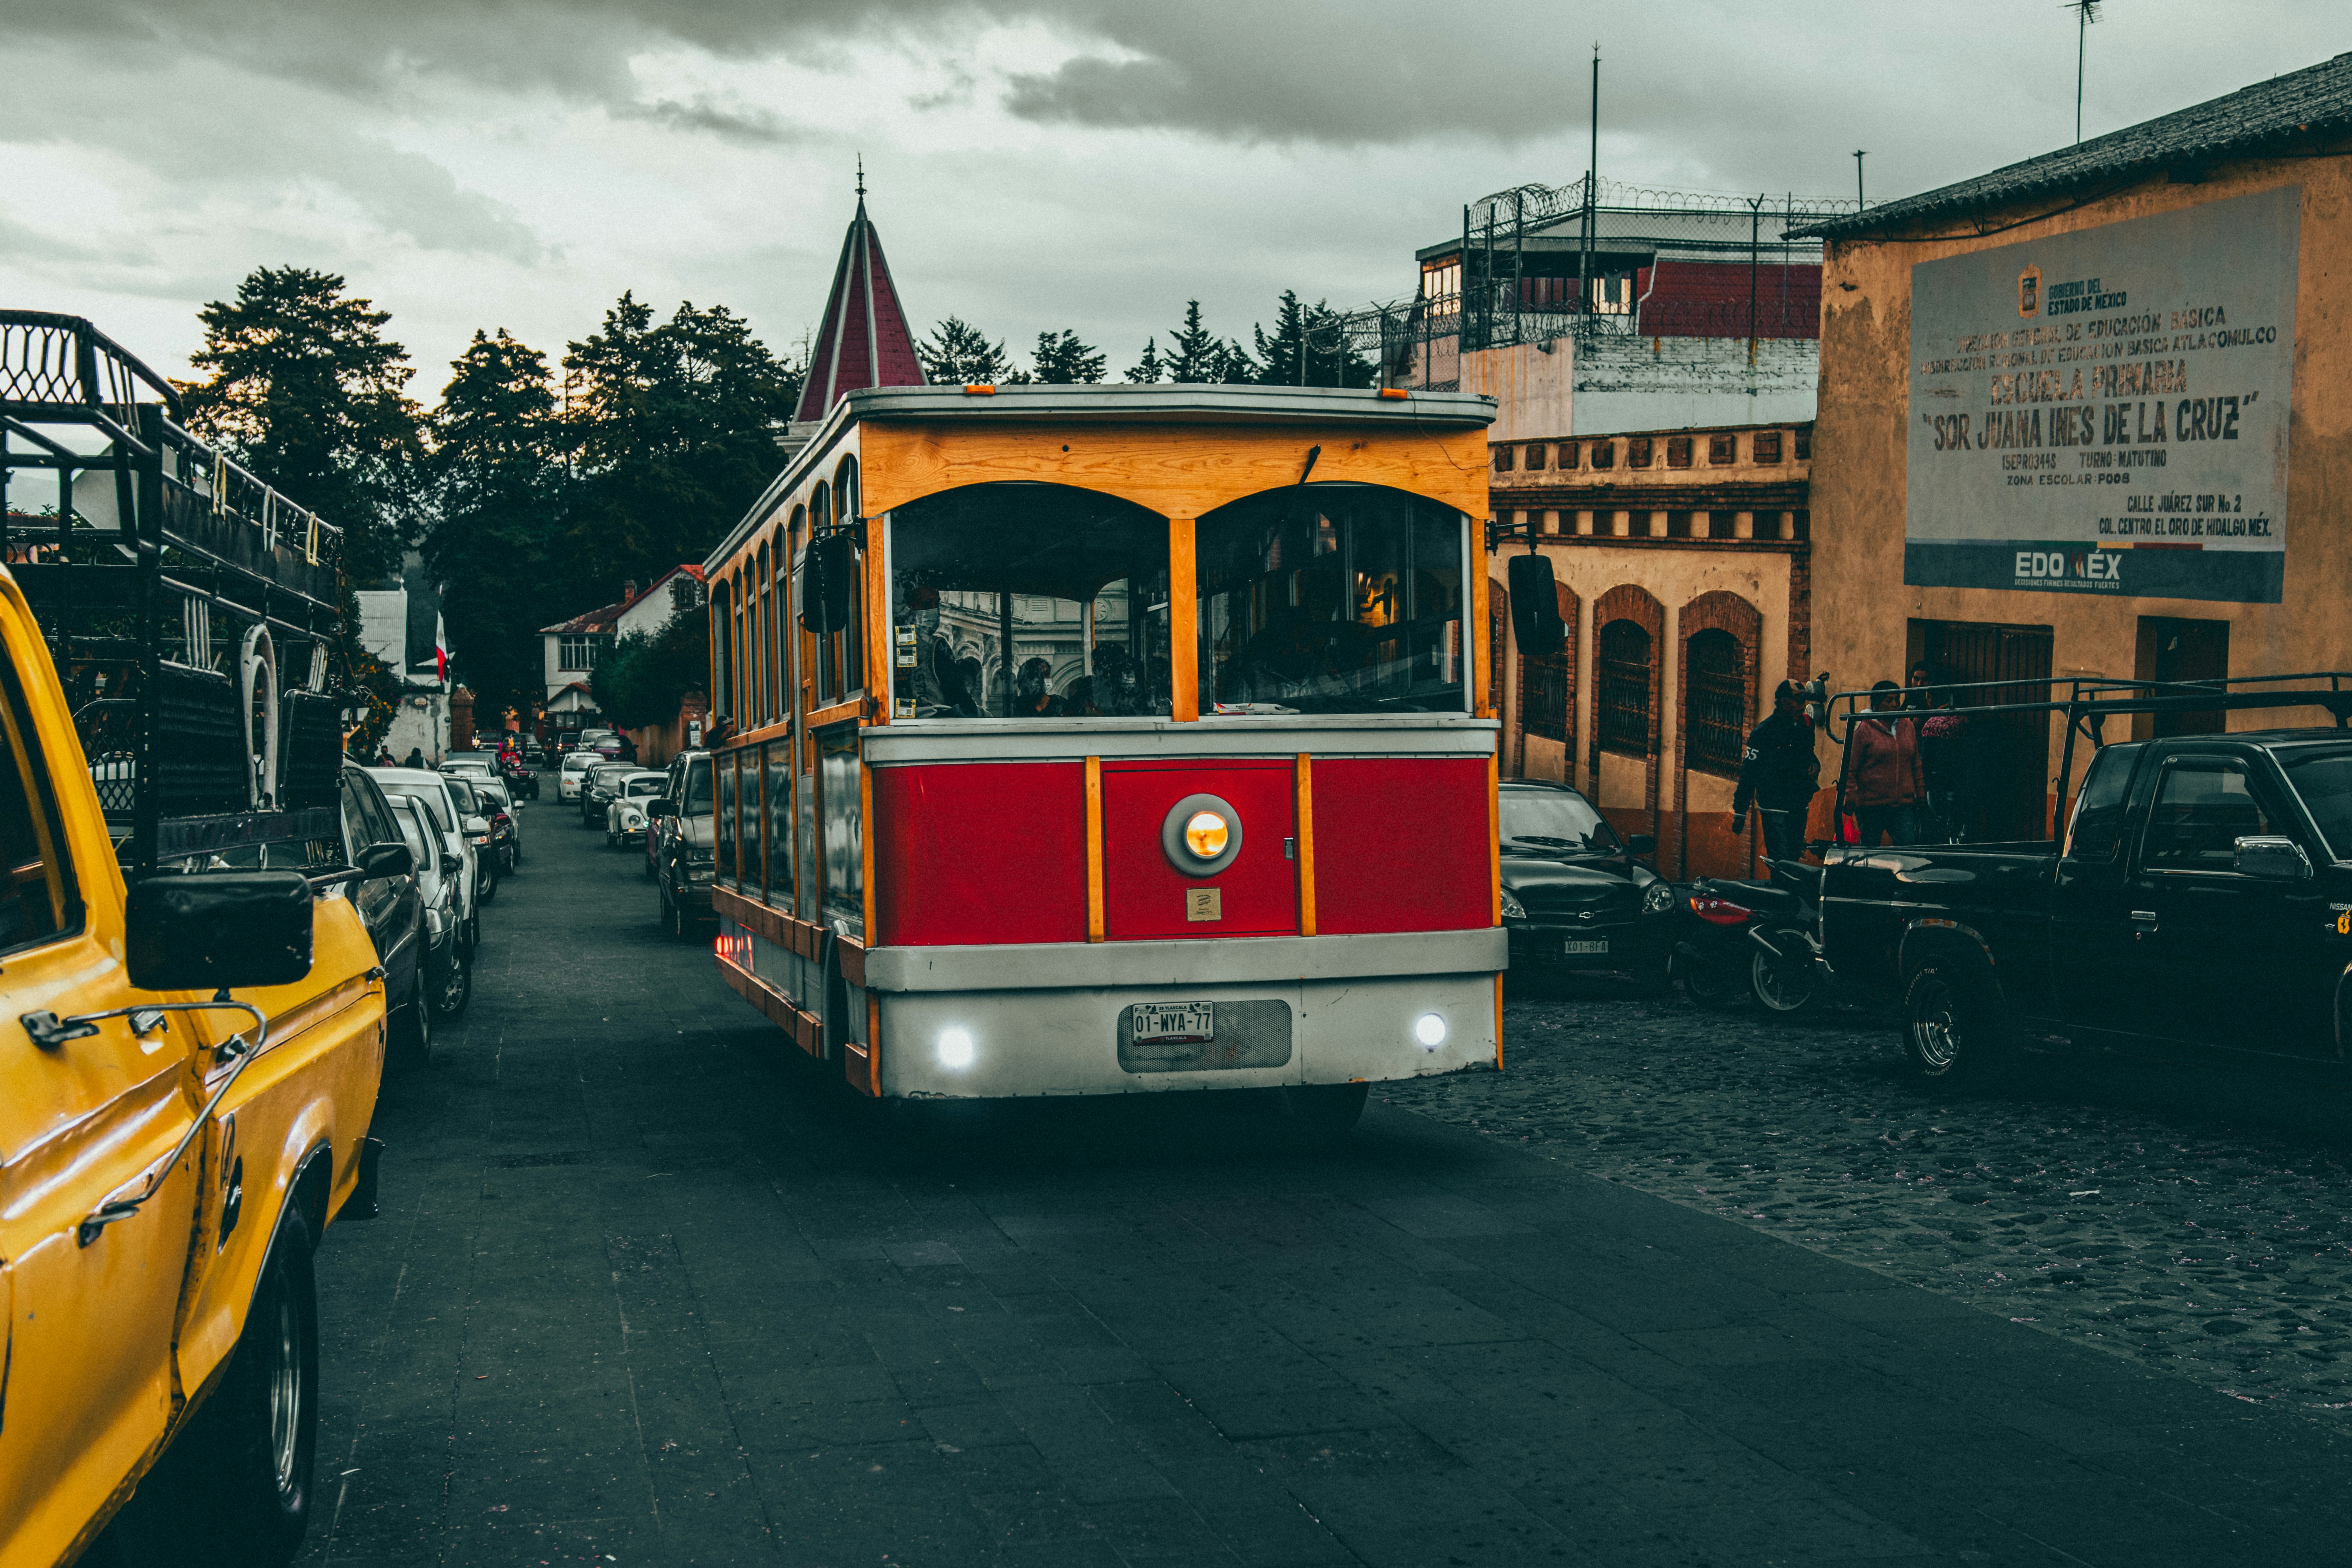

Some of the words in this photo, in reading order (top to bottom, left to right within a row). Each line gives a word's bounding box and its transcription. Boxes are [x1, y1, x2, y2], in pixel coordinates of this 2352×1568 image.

[2049, 280, 2085, 300] GOBIERNO
[2087, 278, 2102, 295] DEL
[2048, 298, 2080, 316] ESTADO
[2081, 296, 2093, 311] DE
[2095, 288, 2127, 310] MÉXICO
[2012, 325, 2062, 347] GENERAL
[2067, 323, 2082, 341] DE
[2088, 308, 2161, 339] EDUCACIÓN
[2171, 302, 2226, 330] BÁSICA
[2041, 348, 2055, 364] DE
[2173, 326, 2277, 351] ATLACOMULCO
[1991, 367, 2083, 406] ESCUELA
[2092, 359, 2187, 399] PRIMARIA
[1977, 409, 2041, 450] JUANA
[2049, 406, 2094, 447] INES
[2104, 403, 2132, 445] DE
[2138, 401, 2167, 443] LA
[2119, 449, 2167, 467] MATUTINO
[2007, 475, 2033, 486] ZONA
[2128, 495, 2154, 513] CALLE
[2158, 490, 2192, 512] JUÁREZ
[2196, 494, 2215, 512] SUR
[2218, 494, 2232, 513] No.
[2234, 494, 2242, 513] 2
[2099, 518, 2117, 534] COL.
[2155, 518, 2167, 535] EL
[2169, 518, 2189, 536] ORO
[2191, 518, 2204, 536] DE
[2249, 512, 2272, 537] MÉX.
[2064, 580, 2092, 588] RESULTADOS
[2330, 902, 2352, 911] NISSAN
[1567, 941, 1606, 952] X01-BFA
[1136, 1013, 1211, 1032] 01-WYA-77
